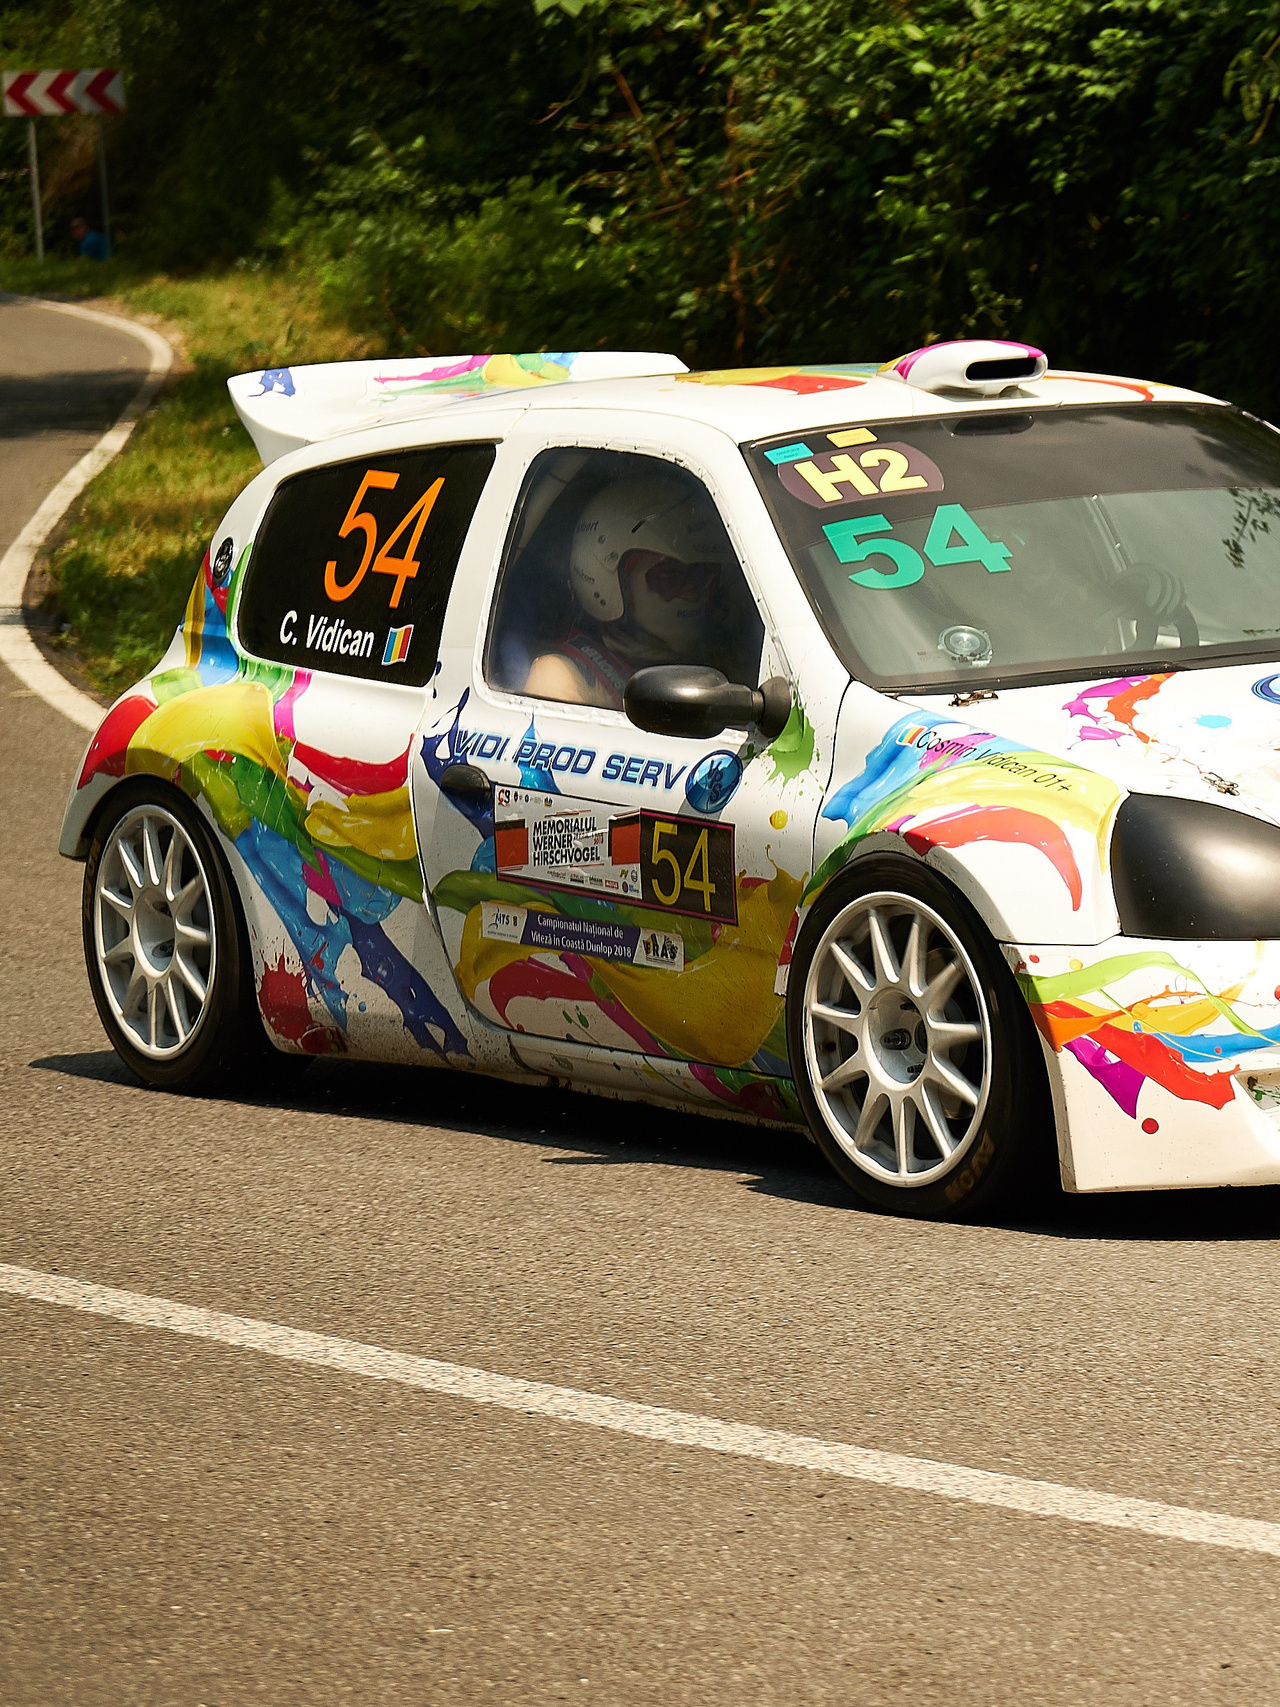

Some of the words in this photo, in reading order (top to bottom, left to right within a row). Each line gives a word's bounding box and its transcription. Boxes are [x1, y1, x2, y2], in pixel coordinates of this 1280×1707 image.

[794, 448, 928, 503] H2
[324, 469, 445, 609] 54
[822, 503, 1013, 590] 54
[279, 610, 298, 646] C.
[305, 614, 375, 658] Vidican
[513, 738, 597, 776] PROD
[602, 753, 688, 791] SERV
[916, 730, 977, 759] Cosmin
[974, 748, 1038, 778] Vidican
[532, 817, 598, 837] MEMORIALUL
[532, 834, 573, 852] WERNER
[532, 846, 601, 867] HIRSCHVOGEL
[651, 820, 716, 912] 54
[537, 914, 582, 932] Campionatul
[614, 926, 624, 939] de
[586, 939, 613, 958] Dunlop
[614, 944, 632, 958] 2018
